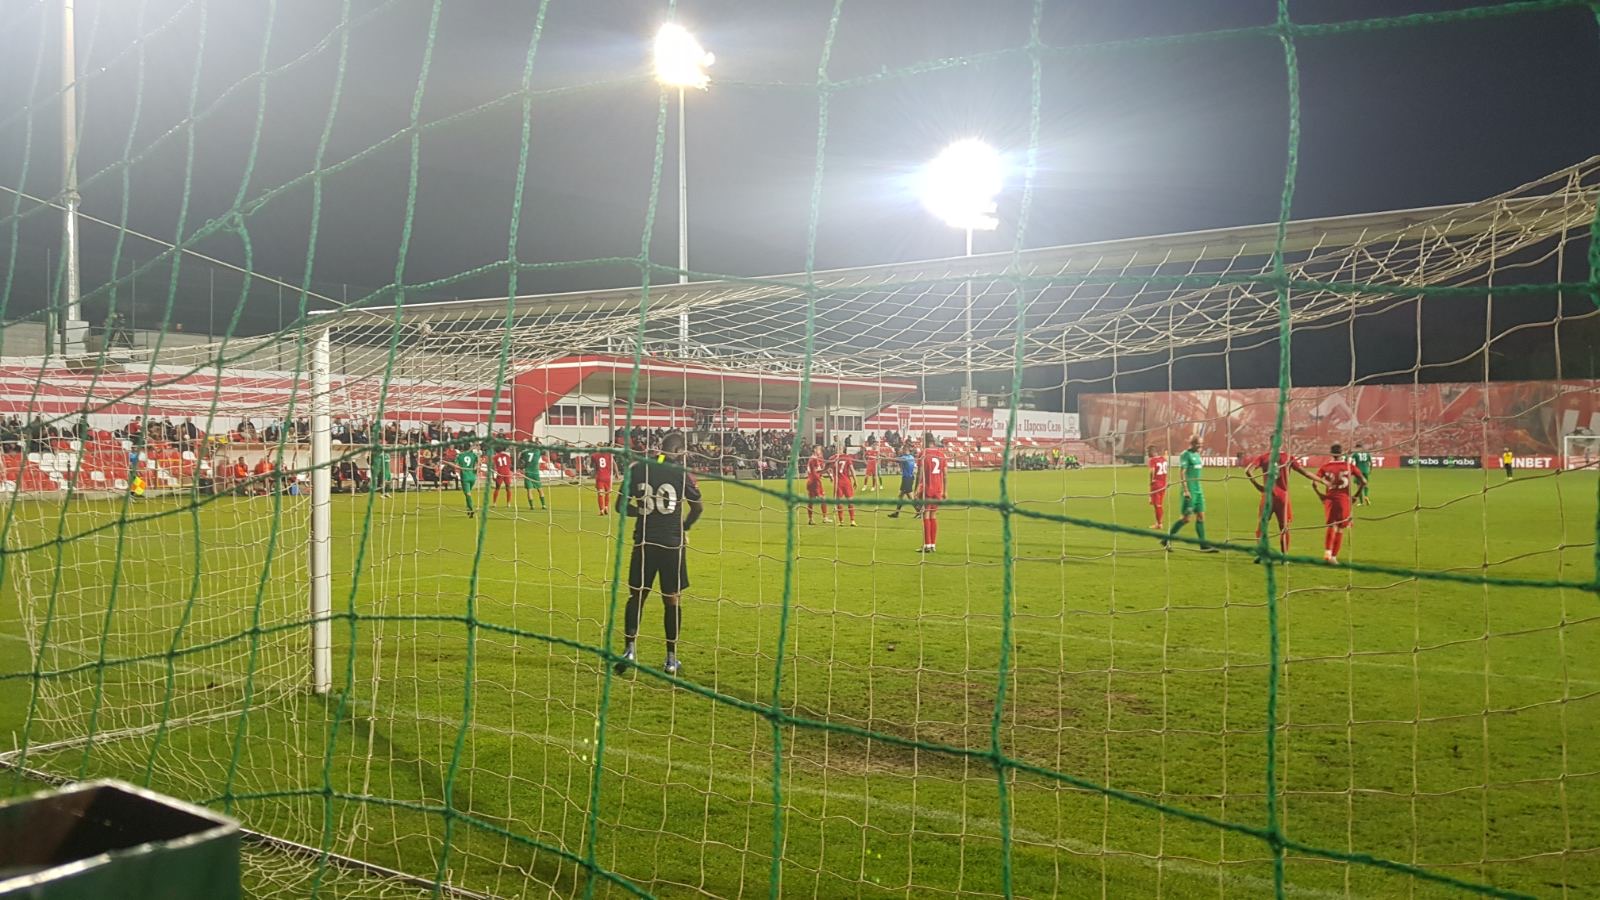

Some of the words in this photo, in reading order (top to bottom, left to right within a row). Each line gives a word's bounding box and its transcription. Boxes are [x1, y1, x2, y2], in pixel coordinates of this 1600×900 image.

[463, 455, 472, 467] 9
[497, 456, 508, 467] 11
[527, 452, 534, 462] 7
[599, 457, 606, 468] 8
[839, 461, 846, 473] 7
[931, 458, 941, 474] 2
[1156, 461, 1168, 475] 20
[637, 482, 677, 516] 30
